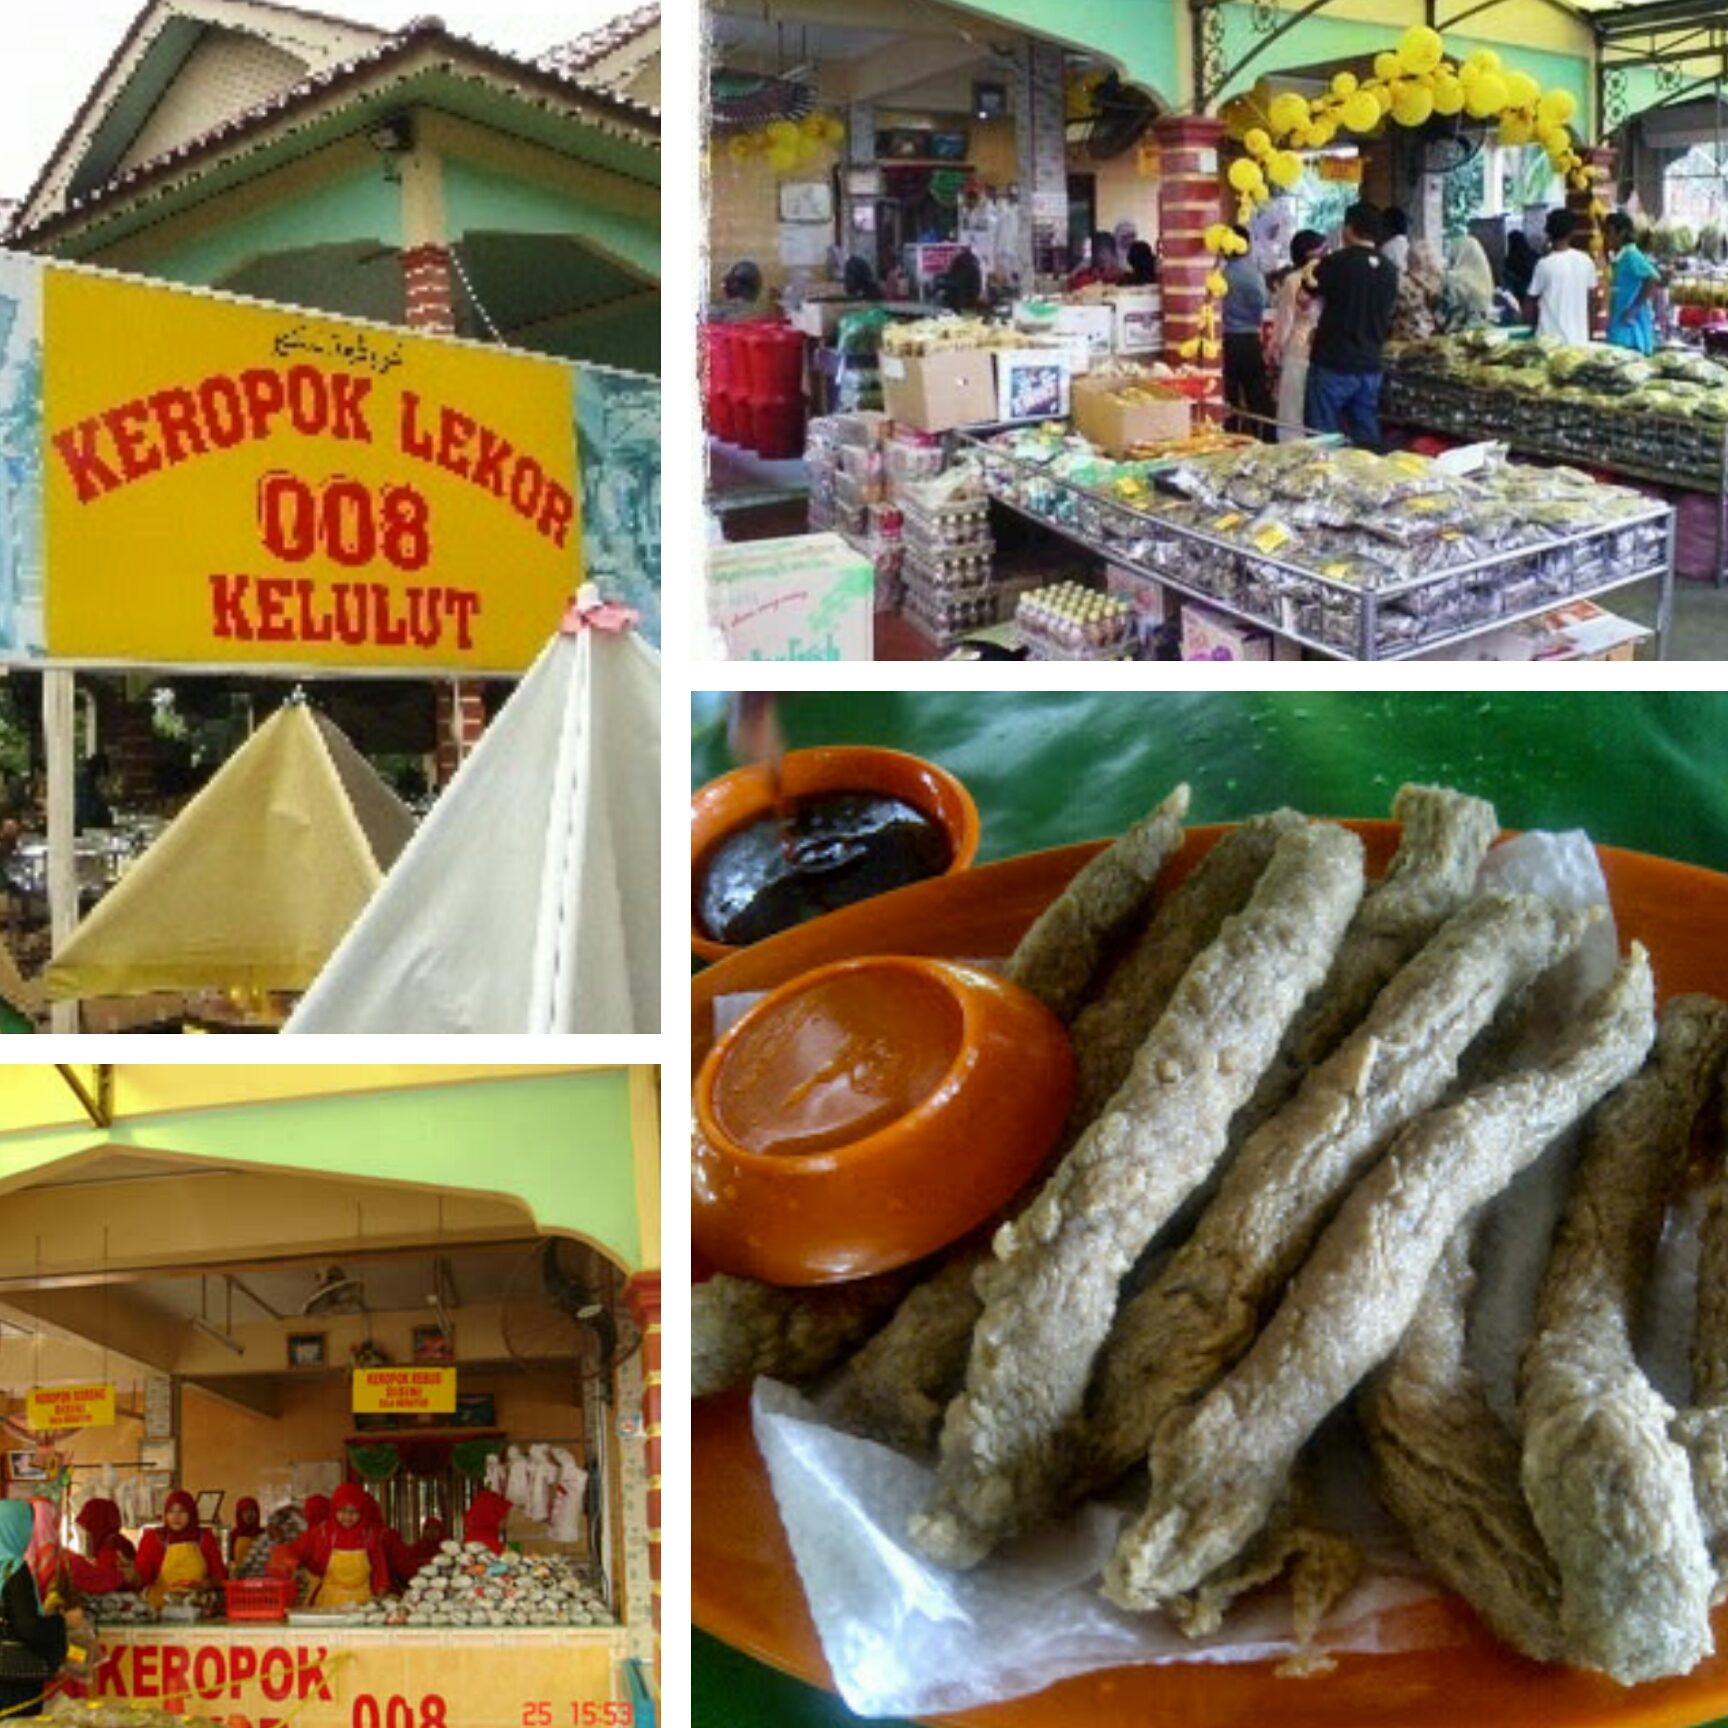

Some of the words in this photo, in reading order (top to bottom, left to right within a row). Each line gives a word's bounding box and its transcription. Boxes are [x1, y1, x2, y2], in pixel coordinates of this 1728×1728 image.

[53, 365, 373, 504] KEROPOK
[400, 391, 575, 549] LEKOR
[256, 470, 431, 571] 008
[210, 575, 481, 650] KELULUT
[97, 1643, 333, 1703] KEROPOK
[351, 1693, 447, 1728] 008
